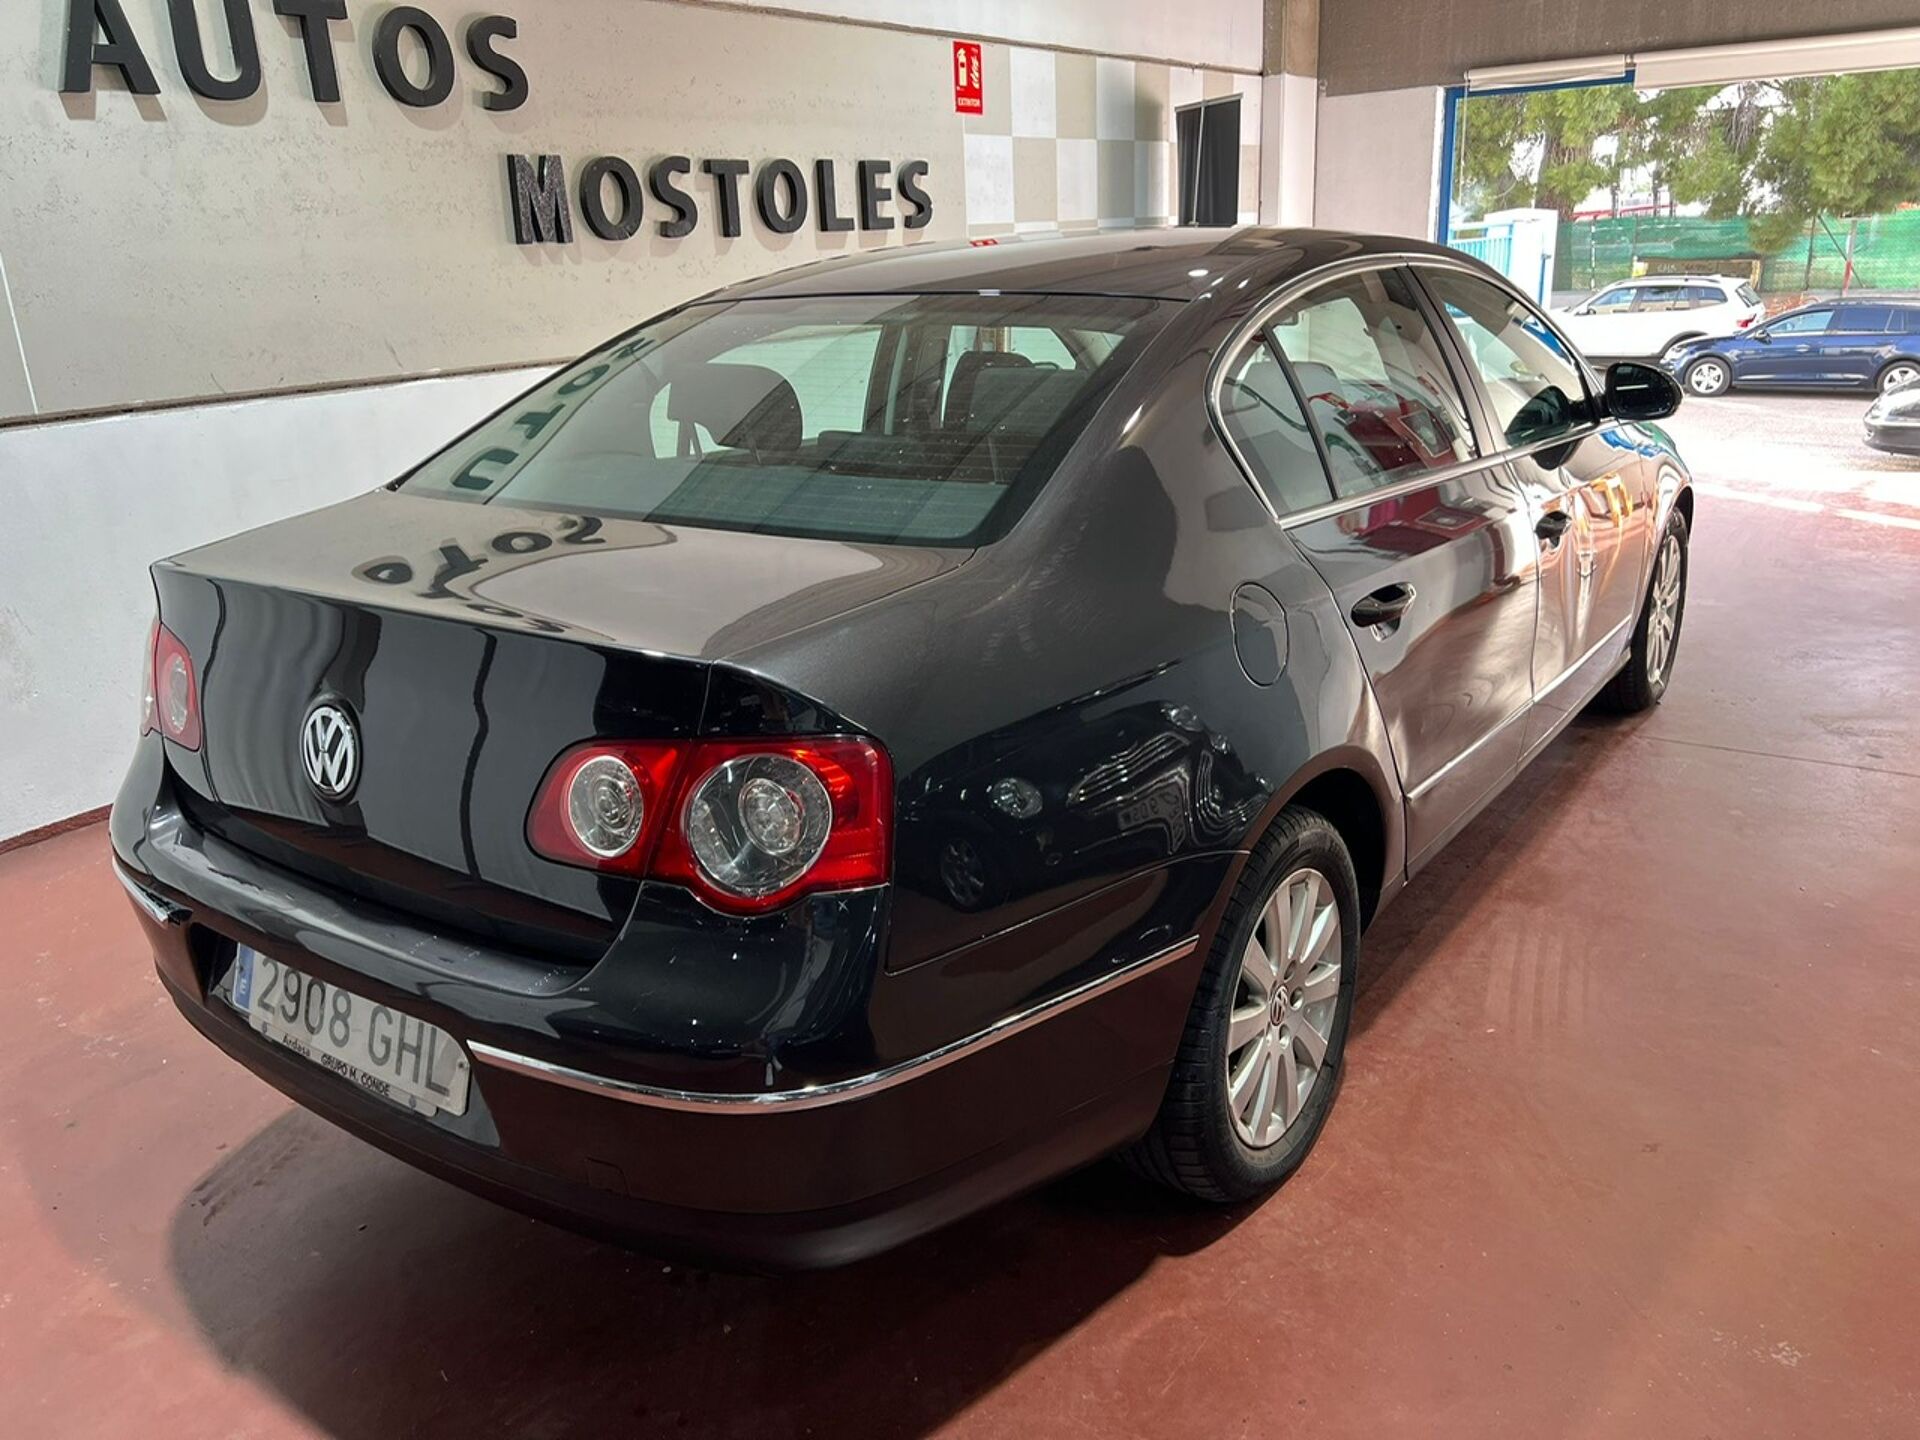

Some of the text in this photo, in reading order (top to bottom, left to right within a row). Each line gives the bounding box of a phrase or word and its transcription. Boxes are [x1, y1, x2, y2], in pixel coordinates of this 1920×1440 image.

[59, 0, 529, 111] AUTOS
[507, 154, 933, 245] MOSTOLES
[257, 957, 450, 1098] 2908 GHL
[320, 1052, 348, 1076] GRUPO
[360, 1071, 392, 1097] CONDE
